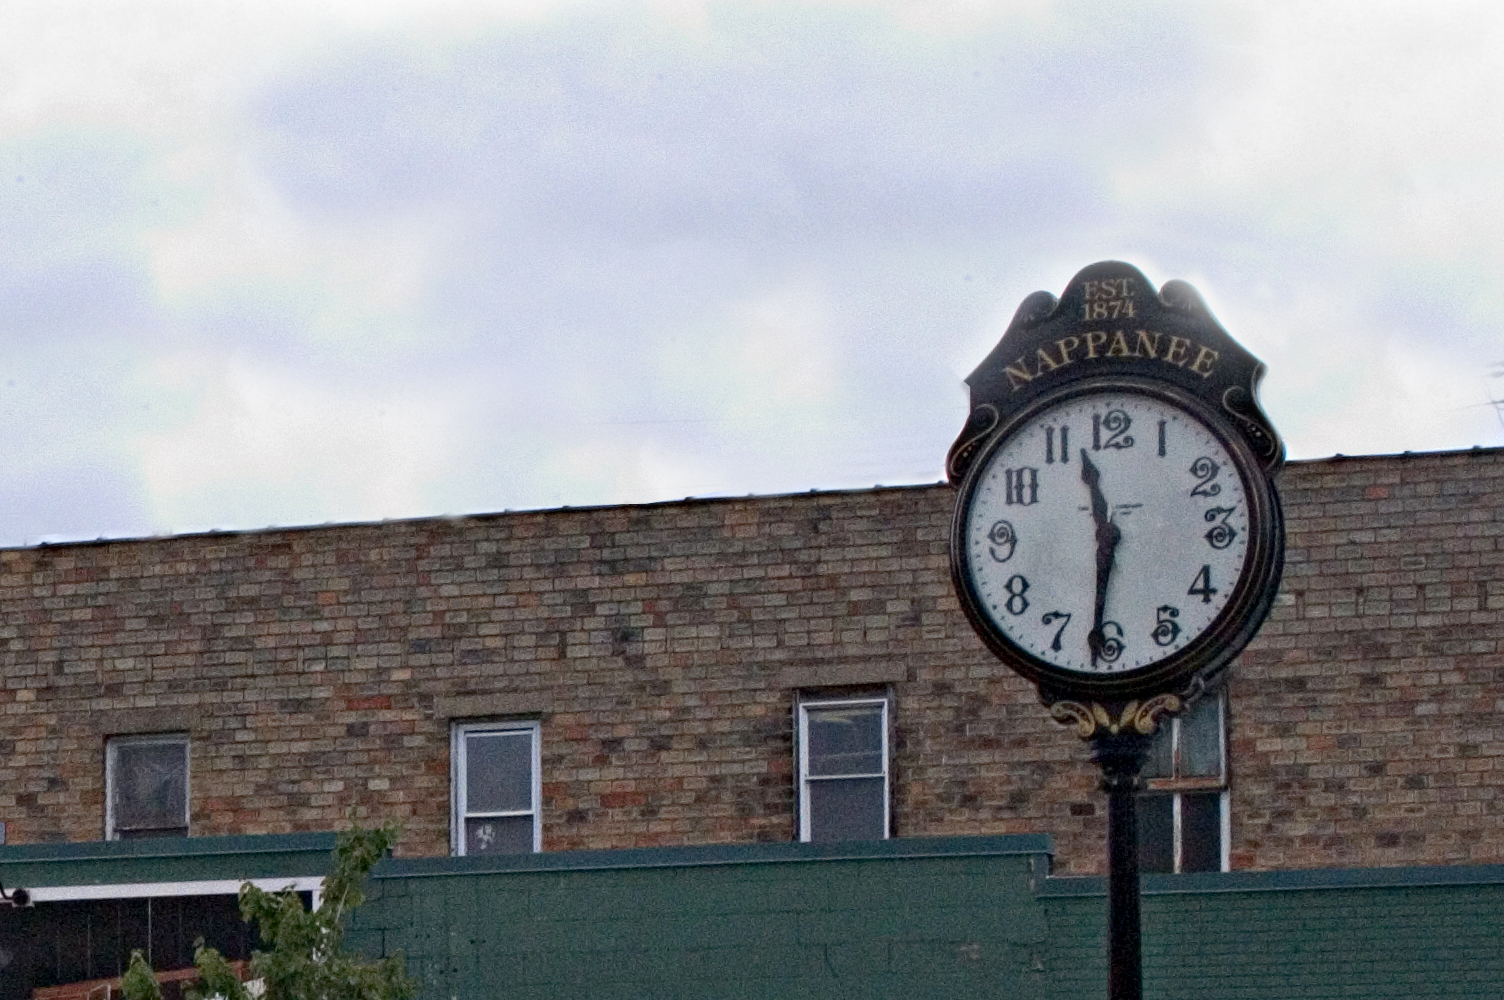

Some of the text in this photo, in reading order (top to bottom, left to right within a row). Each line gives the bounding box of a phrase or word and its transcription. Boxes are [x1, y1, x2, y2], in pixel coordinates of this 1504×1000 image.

[1083, 277, 1136, 300] EST.
[1083, 299, 1136, 321] 1874
[1002, 330, 1219, 392] NAPPANEE
[1045, 424, 1069, 464] 11
[1092, 409, 1135, 451] 12
[1005, 467, 1039, 506] 10
[1189, 456, 1221, 498] 2
[988, 520, 1017, 563] 9
[1204, 506, 1237, 550] 3
[1004, 575, 1030, 616] 8
[1188, 565, 1218, 604] 4
[1042, 611, 1072, 652] 7
[1098, 620, 1126, 663] 6
[1151, 605, 1182, 646] 5
